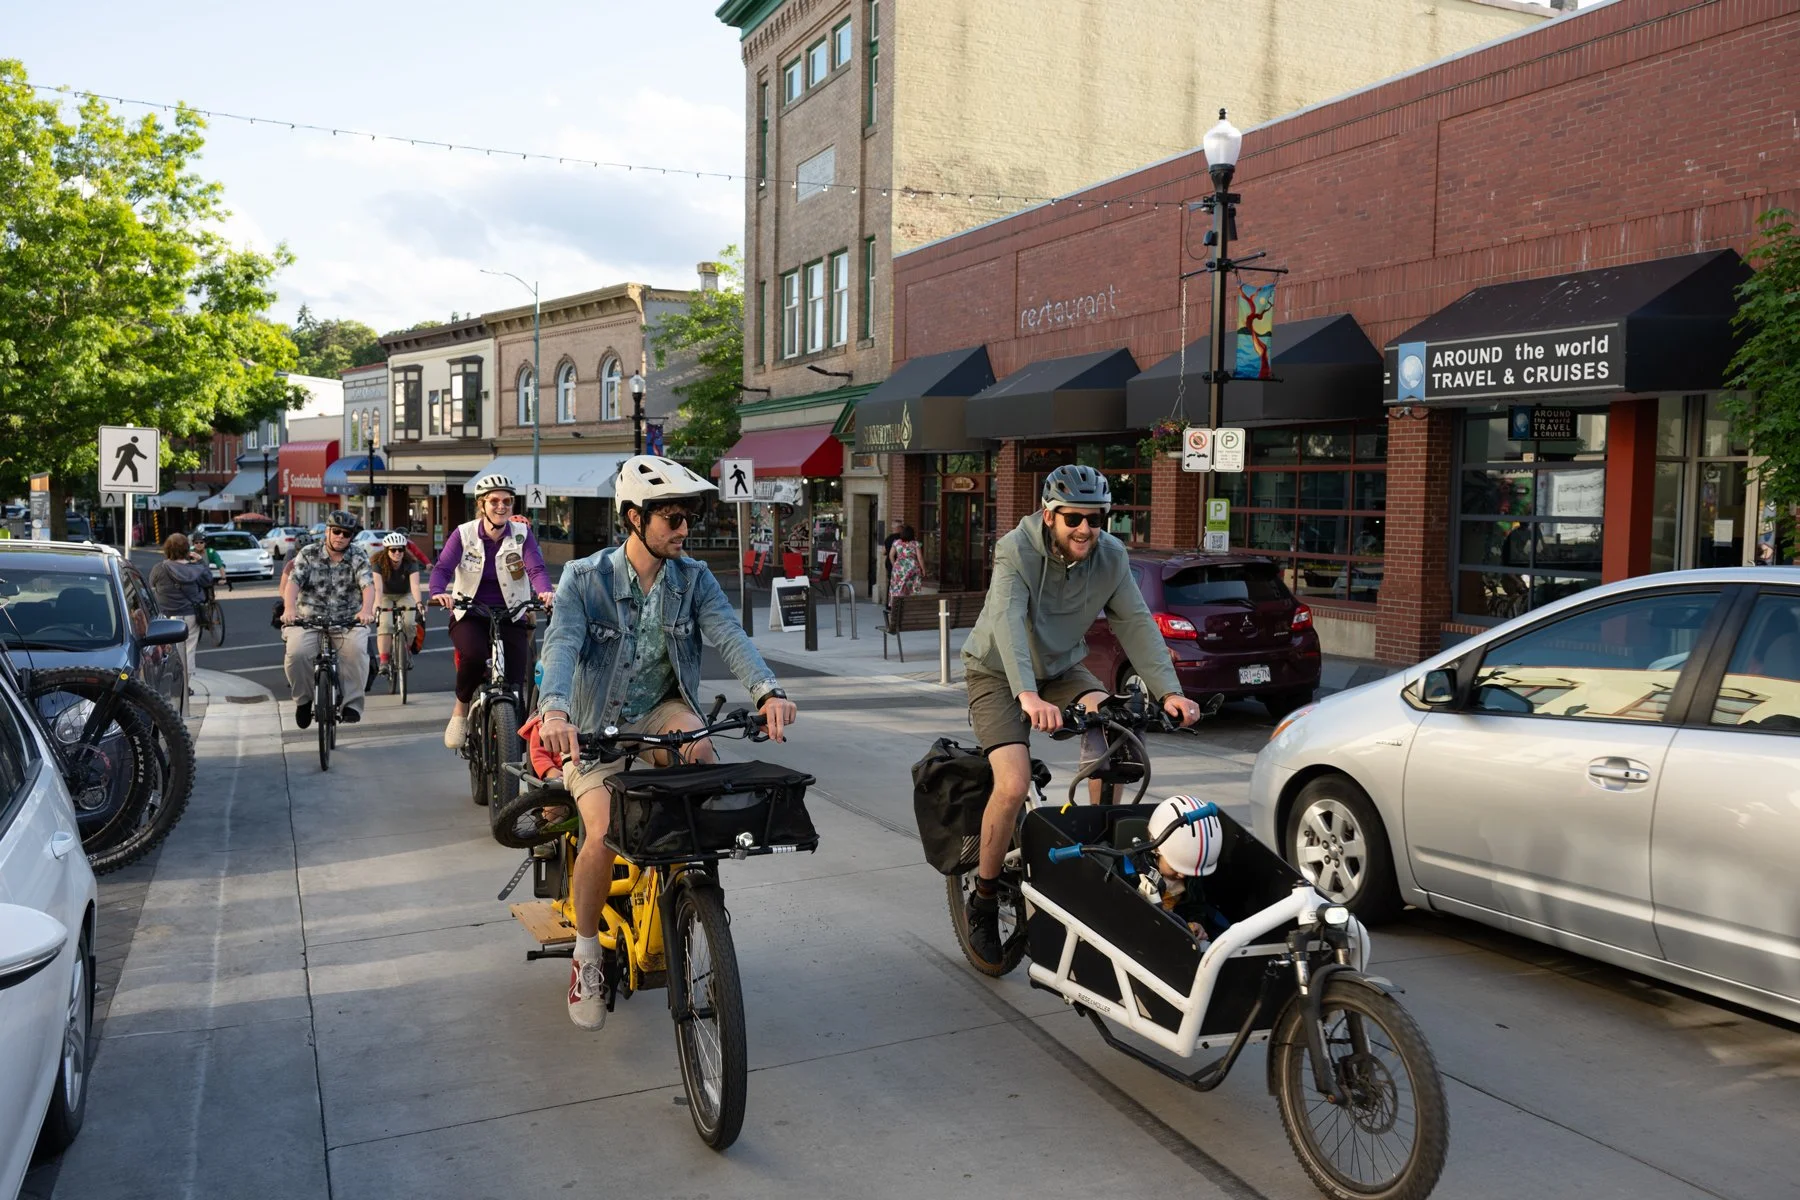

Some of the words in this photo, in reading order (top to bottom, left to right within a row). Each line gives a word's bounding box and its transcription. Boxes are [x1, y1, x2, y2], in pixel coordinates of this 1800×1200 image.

[1021, 284, 1115, 329] restaurant
[1432, 346, 1503, 368] AROUND
[1515, 342, 1545, 360] the
[1555, 334, 1609, 357] world
[1432, 369, 1497, 389] TRAVEL
[1503, 367, 1515, 385] &
[1523, 360, 1609, 384] CRUISES
[1534, 409, 1571, 417] AROUND
[1533, 423, 1571, 431] TRAVEL
[291, 473, 322, 488] Scotiabank
